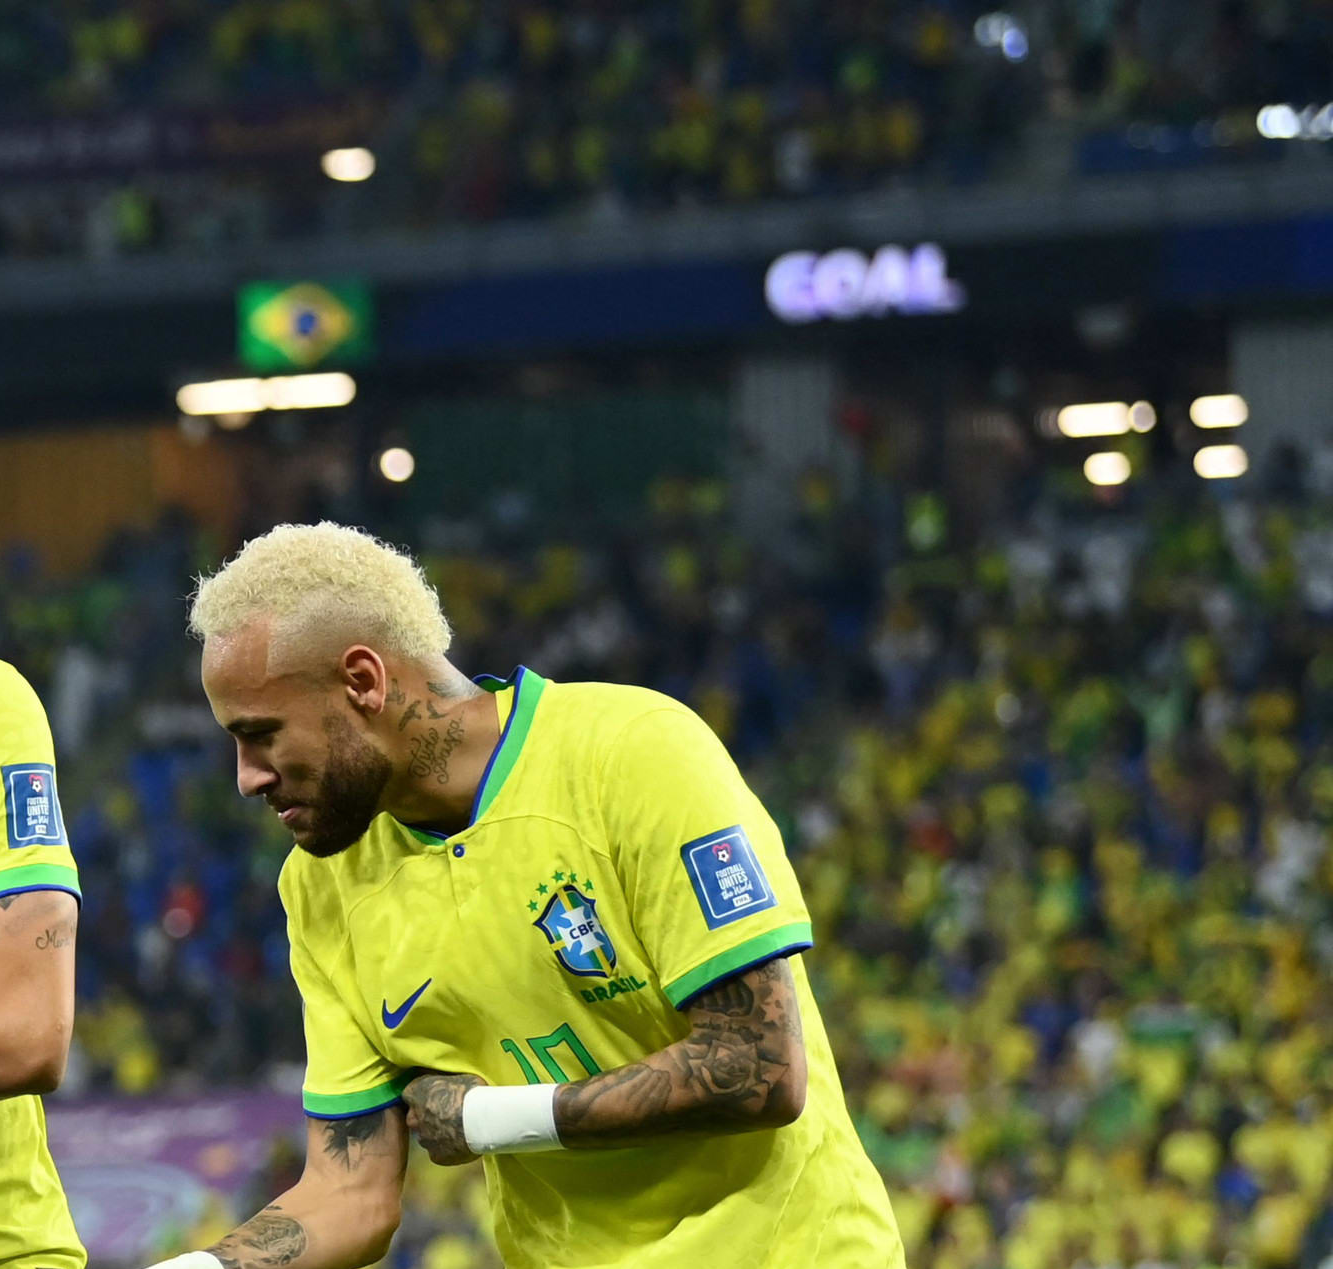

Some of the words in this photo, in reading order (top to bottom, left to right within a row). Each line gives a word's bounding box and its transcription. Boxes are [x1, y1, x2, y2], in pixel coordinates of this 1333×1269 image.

[764, 242, 966, 324] GOAL
[569, 921, 596, 940] CBF
[580, 976, 646, 1003] BRASIL
